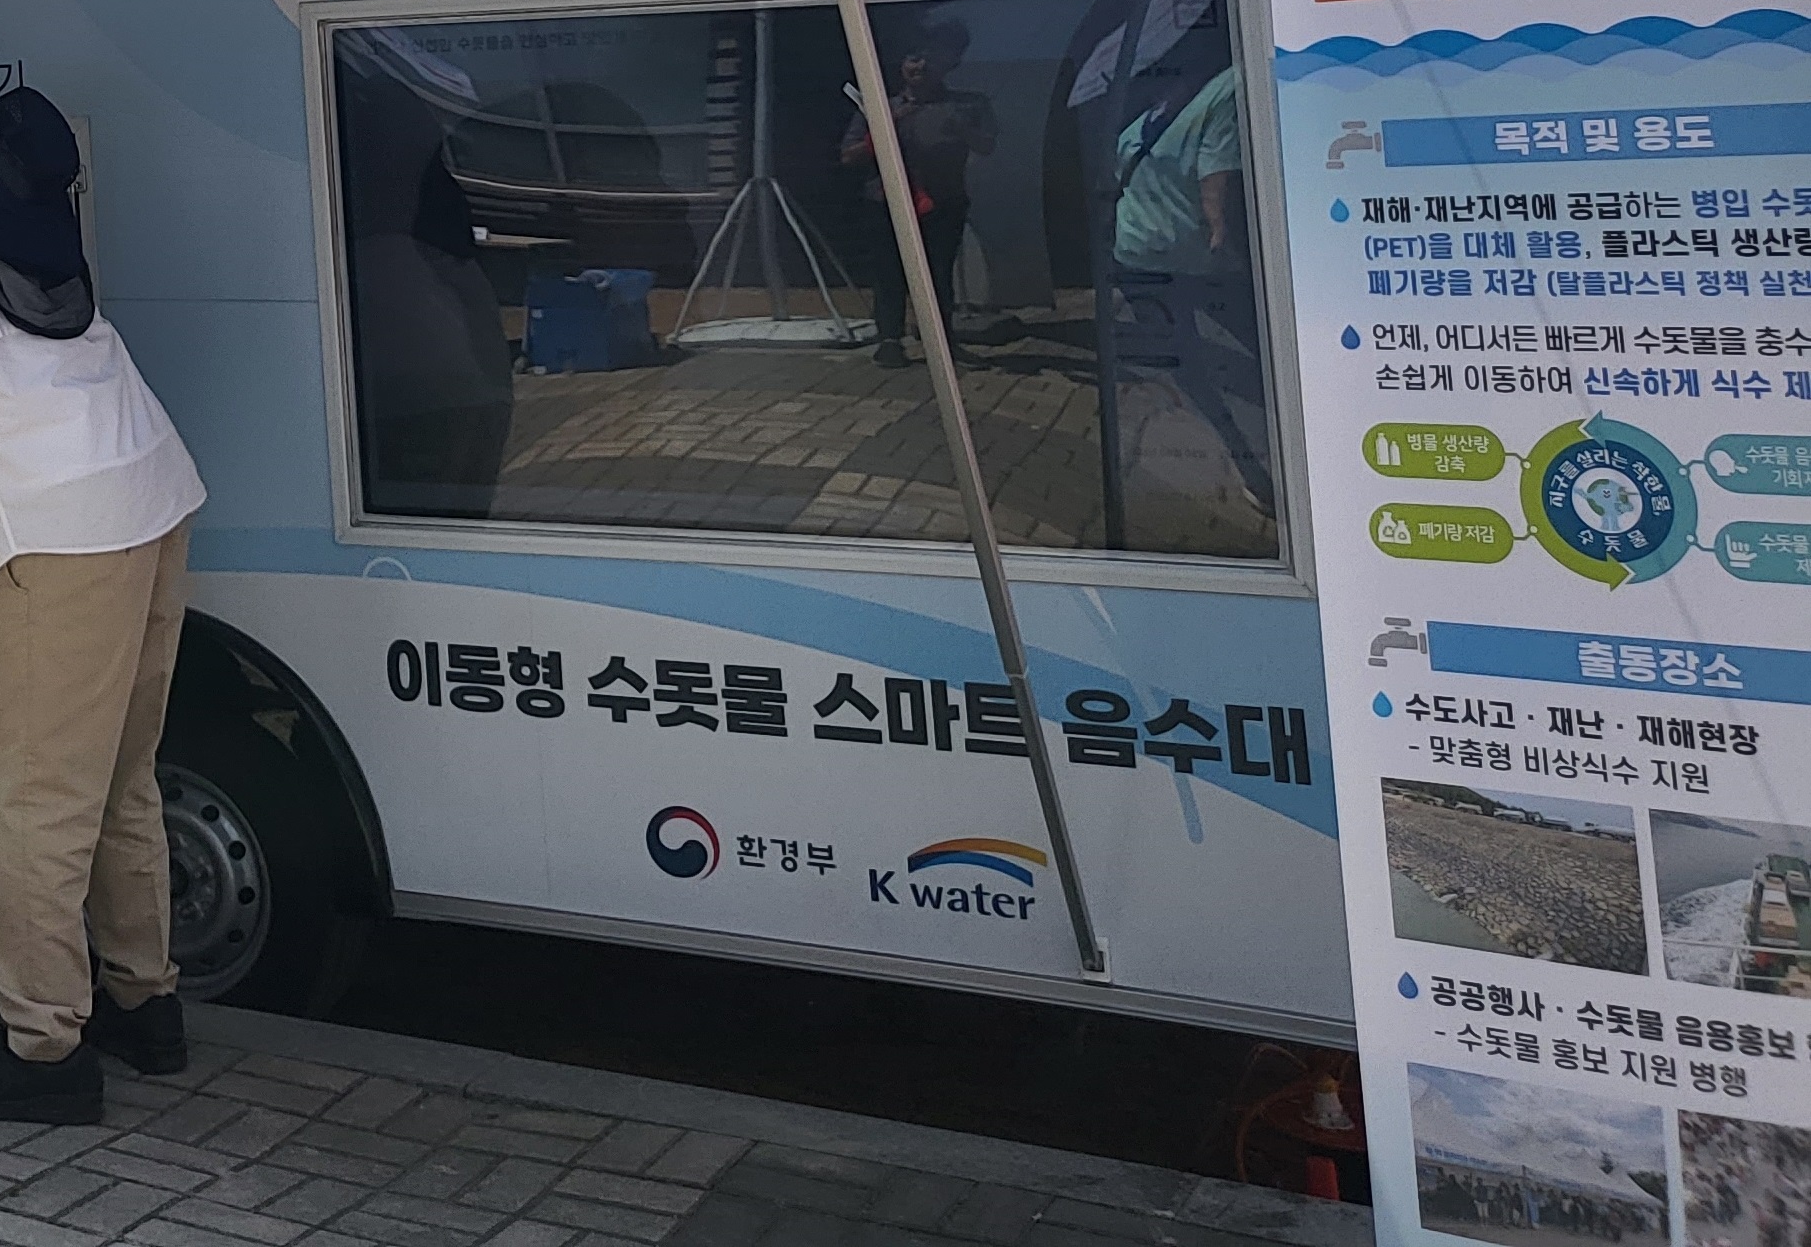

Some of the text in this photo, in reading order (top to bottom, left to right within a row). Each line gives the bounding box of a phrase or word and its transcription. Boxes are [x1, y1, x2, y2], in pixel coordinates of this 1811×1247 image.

[1494, 115, 1715, 156] 목적 및 용도
[1361, 193, 1557, 224] 재해·재난지역에
[1567, 191, 1682, 221] 공급하는
[1691, 188, 1751, 220] 병입
[1364, 231, 1454, 261] (PET)을
[1464, 231, 1516, 260] 대체
[1526, 231, 1592, 260] 활용,
[1601, 229, 1718, 258] 플라스틱
[1368, 269, 1472, 296] 폐기량을
[1484, 268, 1537, 297] 저감
[1547, 270, 1686, 298] (탈플라스틱
[1696, 270, 1750, 297] 정책
[1372, 322, 1429, 354] 언제,
[1436, 323, 1538, 354] 어디서든
[1545, 325, 1626, 354] 빠르게
[1633, 325, 1746, 356] 수돗물을
[1375, 364, 1454, 393] 손쉽게
[1464, 365, 1572, 395] 이동하여
[1583, 367, 1700, 399] 신속하게
[1711, 370, 1773, 400] 식수
[1407, 433, 1490, 454] 병물 생산량
[1433, 454, 1467, 473] 감축
[1418, 522, 1496, 544] 폐기량 저감
[1577, 640, 1744, 691] 출동장소
[388, 638, 1312, 787] 이동형 수돗물 스마트 음수대
[1405, 692, 1760, 756] 수도사고 재난 재해현장
[1429, 734, 1711, 794] 맞춤형 비상식수 지원
[735, 833, 838, 878] 환경부
[868, 868, 1036, 921] K water
[1430, 974, 1546, 1022] 공공행사
[1576, 1001, 1664, 1043] 수돗물
[1675, 1014, 1794, 1060] 음용홍보
[1456, 1022, 1749, 1098] 수돗물 홍보 지원 병행
